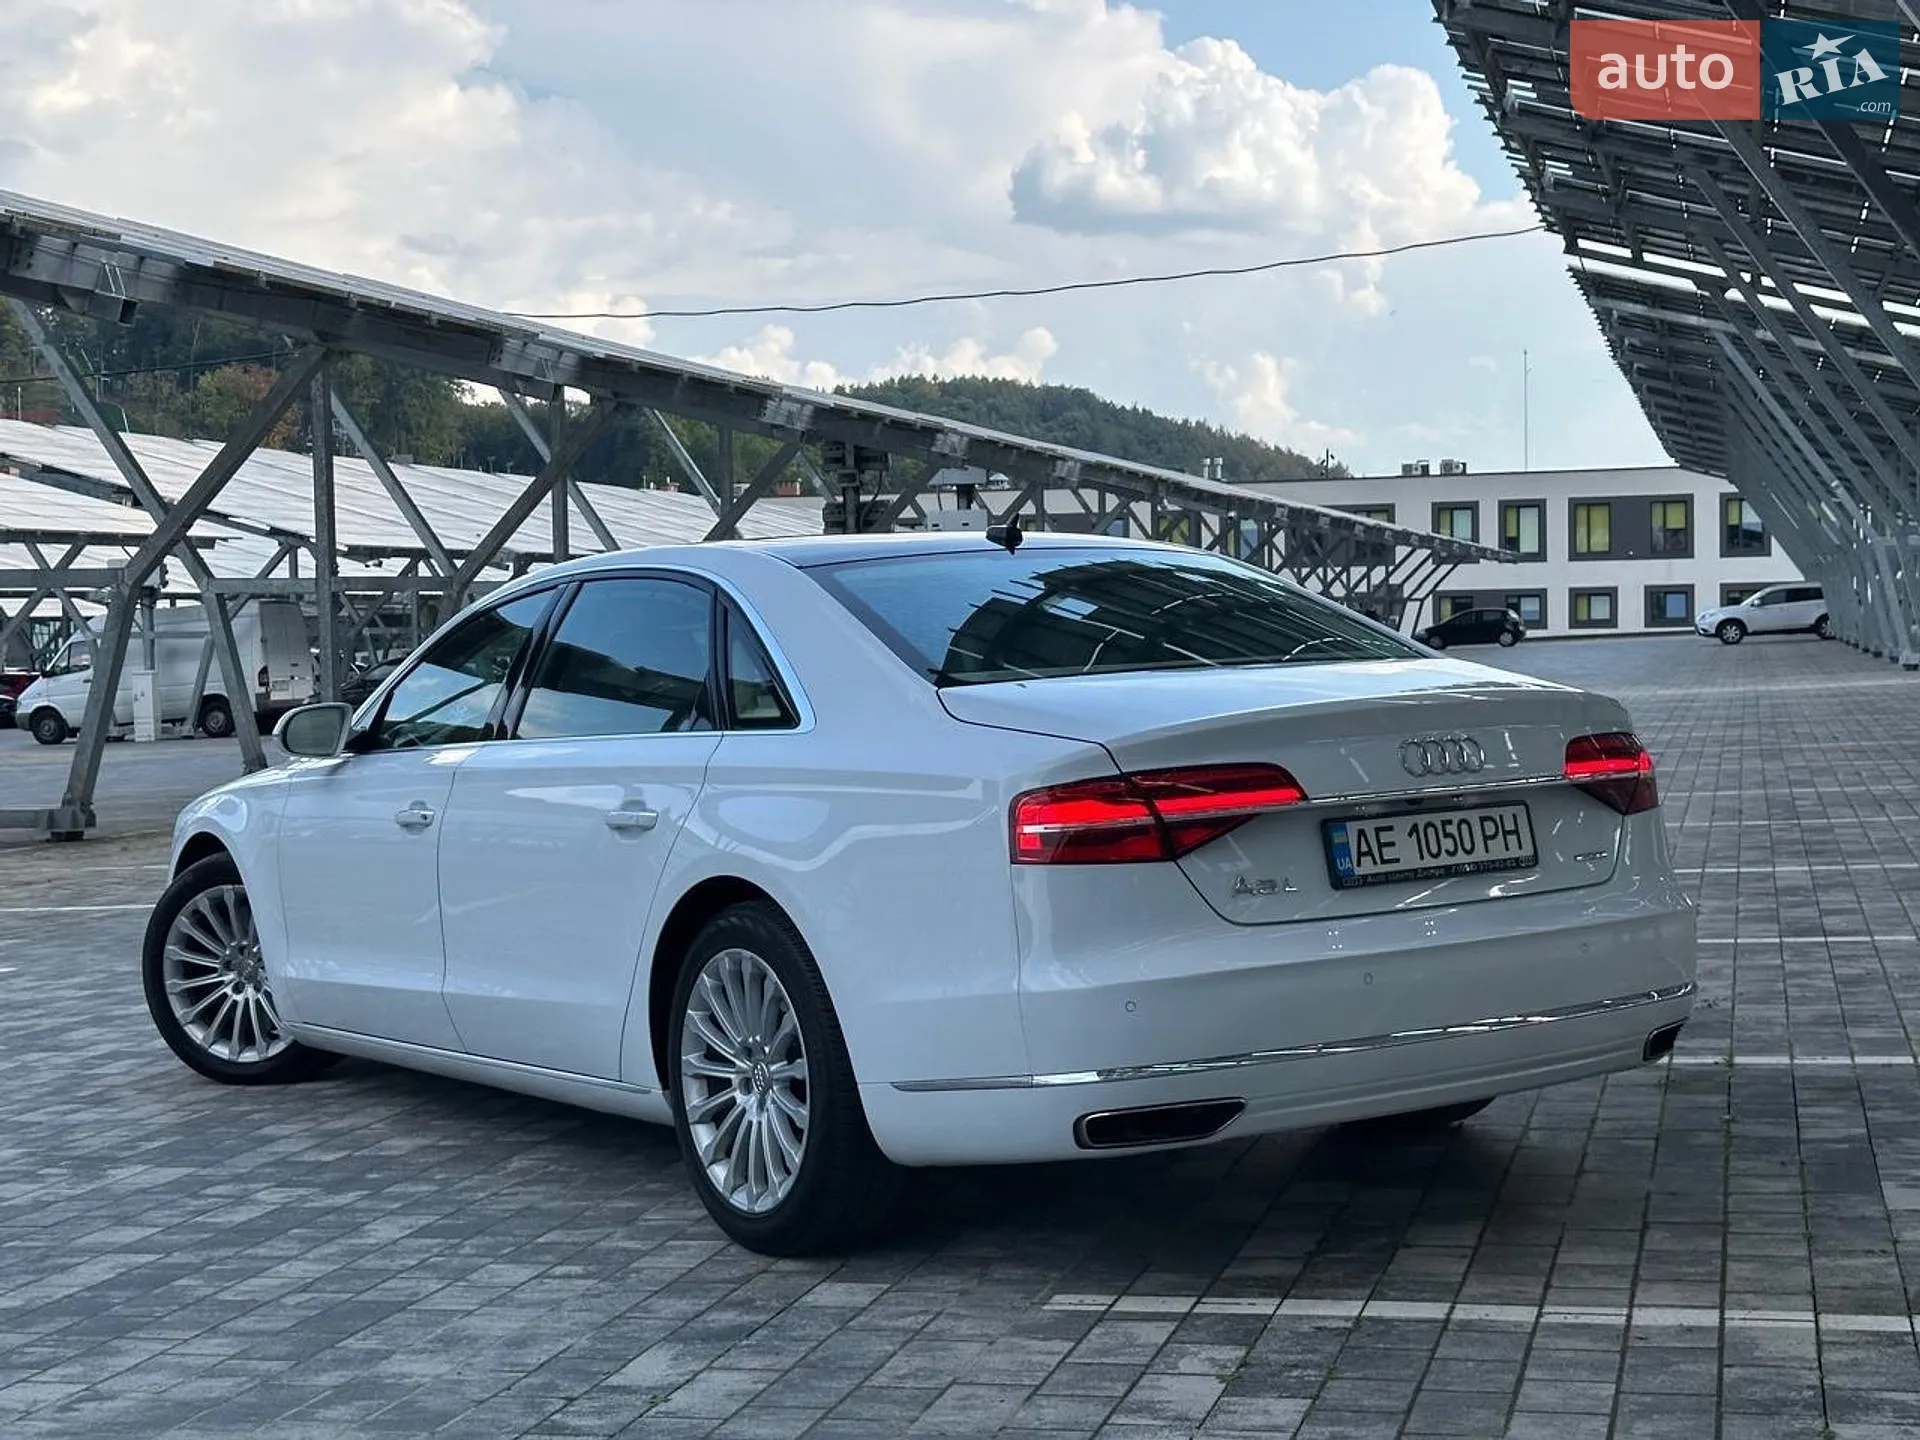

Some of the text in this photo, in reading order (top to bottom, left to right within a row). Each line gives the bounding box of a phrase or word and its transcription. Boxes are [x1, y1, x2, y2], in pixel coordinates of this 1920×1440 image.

[1356, 812, 1524, 867] AE 1050 PH
[1336, 857, 1355, 870] UA
